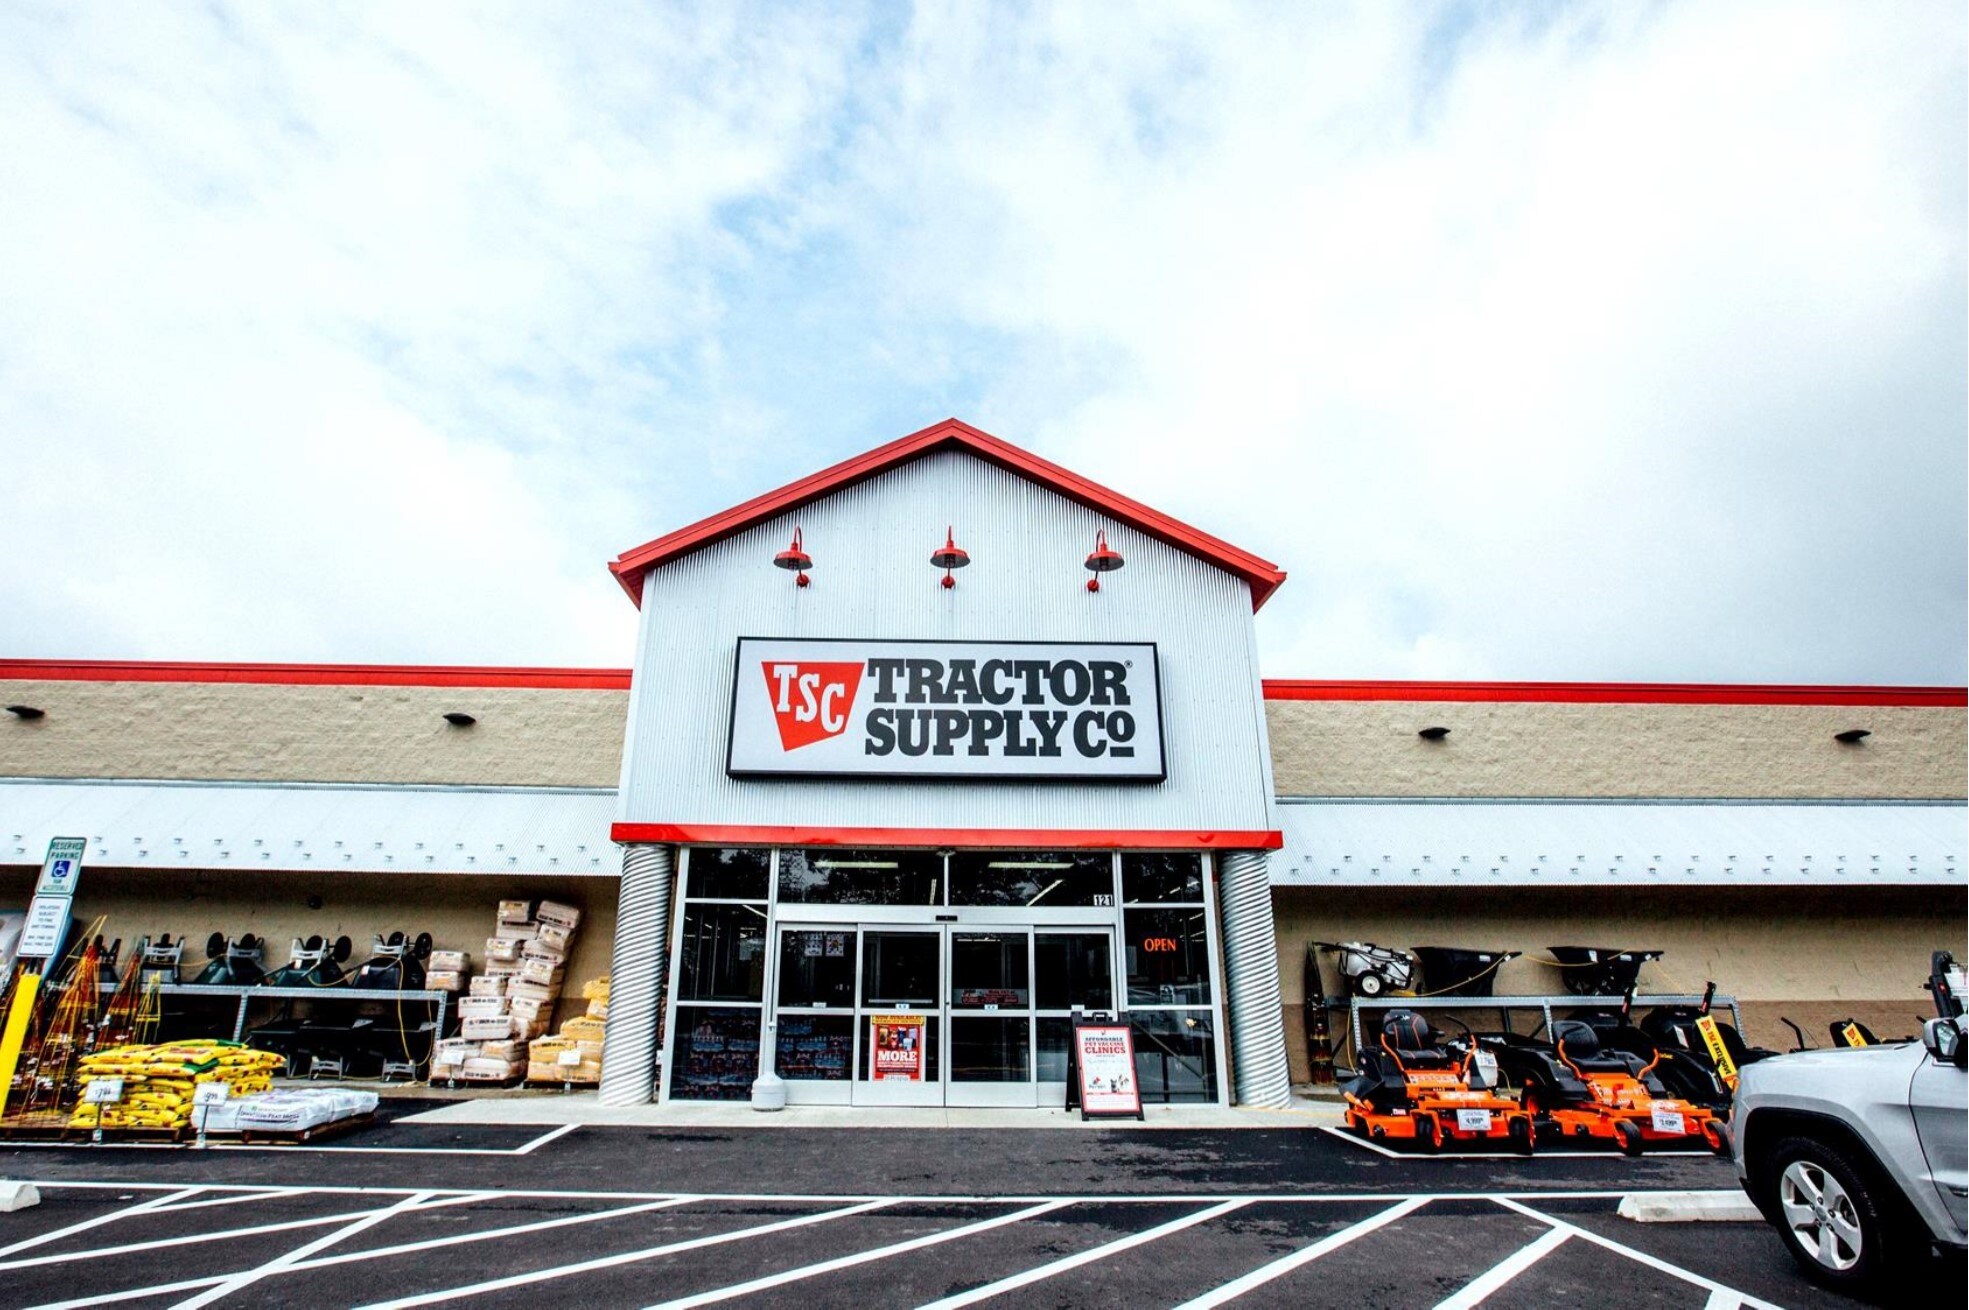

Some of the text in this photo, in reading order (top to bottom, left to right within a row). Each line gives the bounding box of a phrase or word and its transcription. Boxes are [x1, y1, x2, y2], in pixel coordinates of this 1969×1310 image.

[868, 658, 1131, 706] TRACTOR
[773, 664, 845, 733] TSC
[865, 708, 1067, 757] SUPPLY
[52, 842, 83, 850] RESERVED
[1095, 895, 1112, 906] 121
[1144, 938, 1177, 952] OPEN
[877, 1050, 918, 1061] MORE
